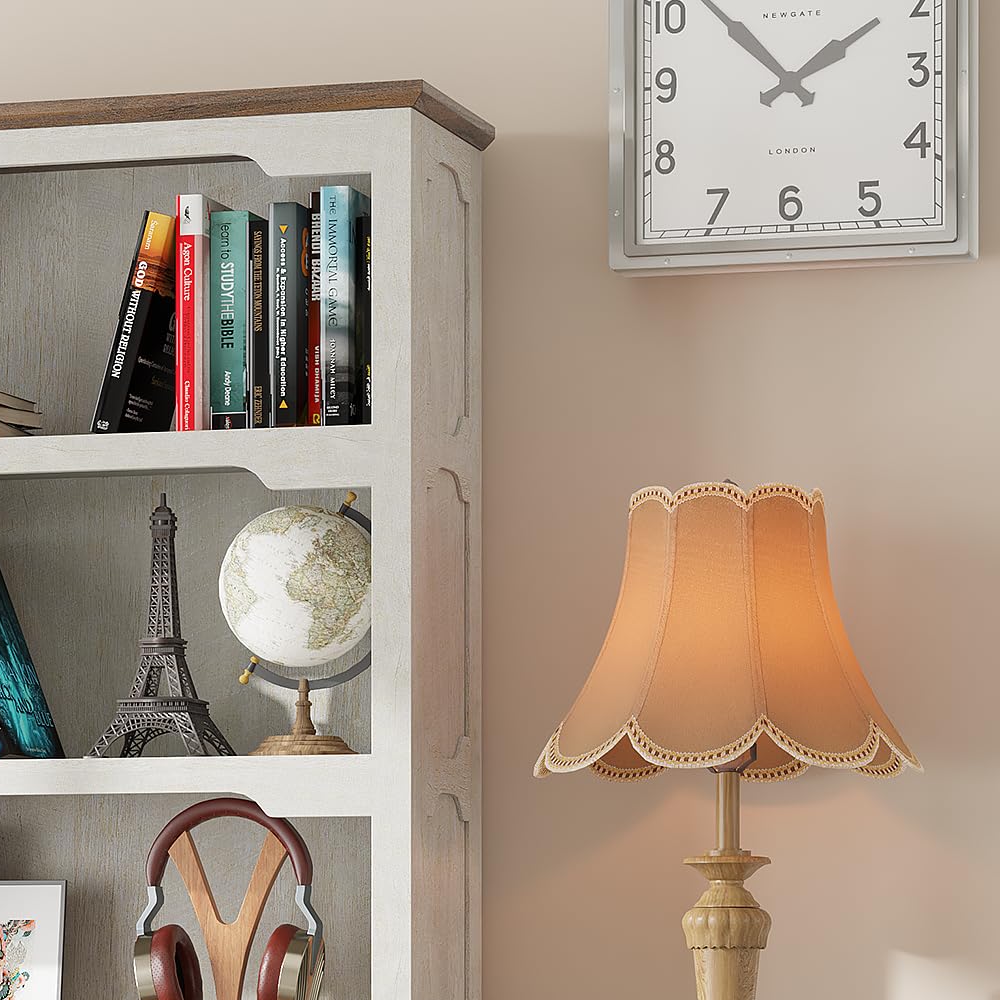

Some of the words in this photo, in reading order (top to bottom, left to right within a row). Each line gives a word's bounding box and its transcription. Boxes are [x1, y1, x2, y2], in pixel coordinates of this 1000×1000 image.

[655, 0, 686, 34] 10
[762, 9, 822, 19] NEWGATE
[655, 67, 677, 103] 9
[907, 52, 930, 88] 3
[655, 140, 676, 175] 8
[768, 146, 817, 156] LONDON
[903, 122, 931, 159] 4
[706, 188, 730, 225] 7
[778, 185, 803, 221] 6
[858, 180, 882, 217] 5
[220, 223, 232, 247] learn
[311, 213, 320, 254] BHENDI
[327, 219, 338, 284] IMMORTAL
[182, 242, 193, 266] Agon
[135, 261, 147, 288] GOD
[183, 268, 193, 301] Culture
[311, 259, 320, 301] BAZAAR
[123, 289, 141, 333] WITHOUT
[253, 300, 262, 332] MOUNTAINS
[328, 288, 338, 327] GAME
[111, 334, 131, 379] RELIGION
[223, 370, 232, 387] Andy
[224, 387, 232, 406] Deane
